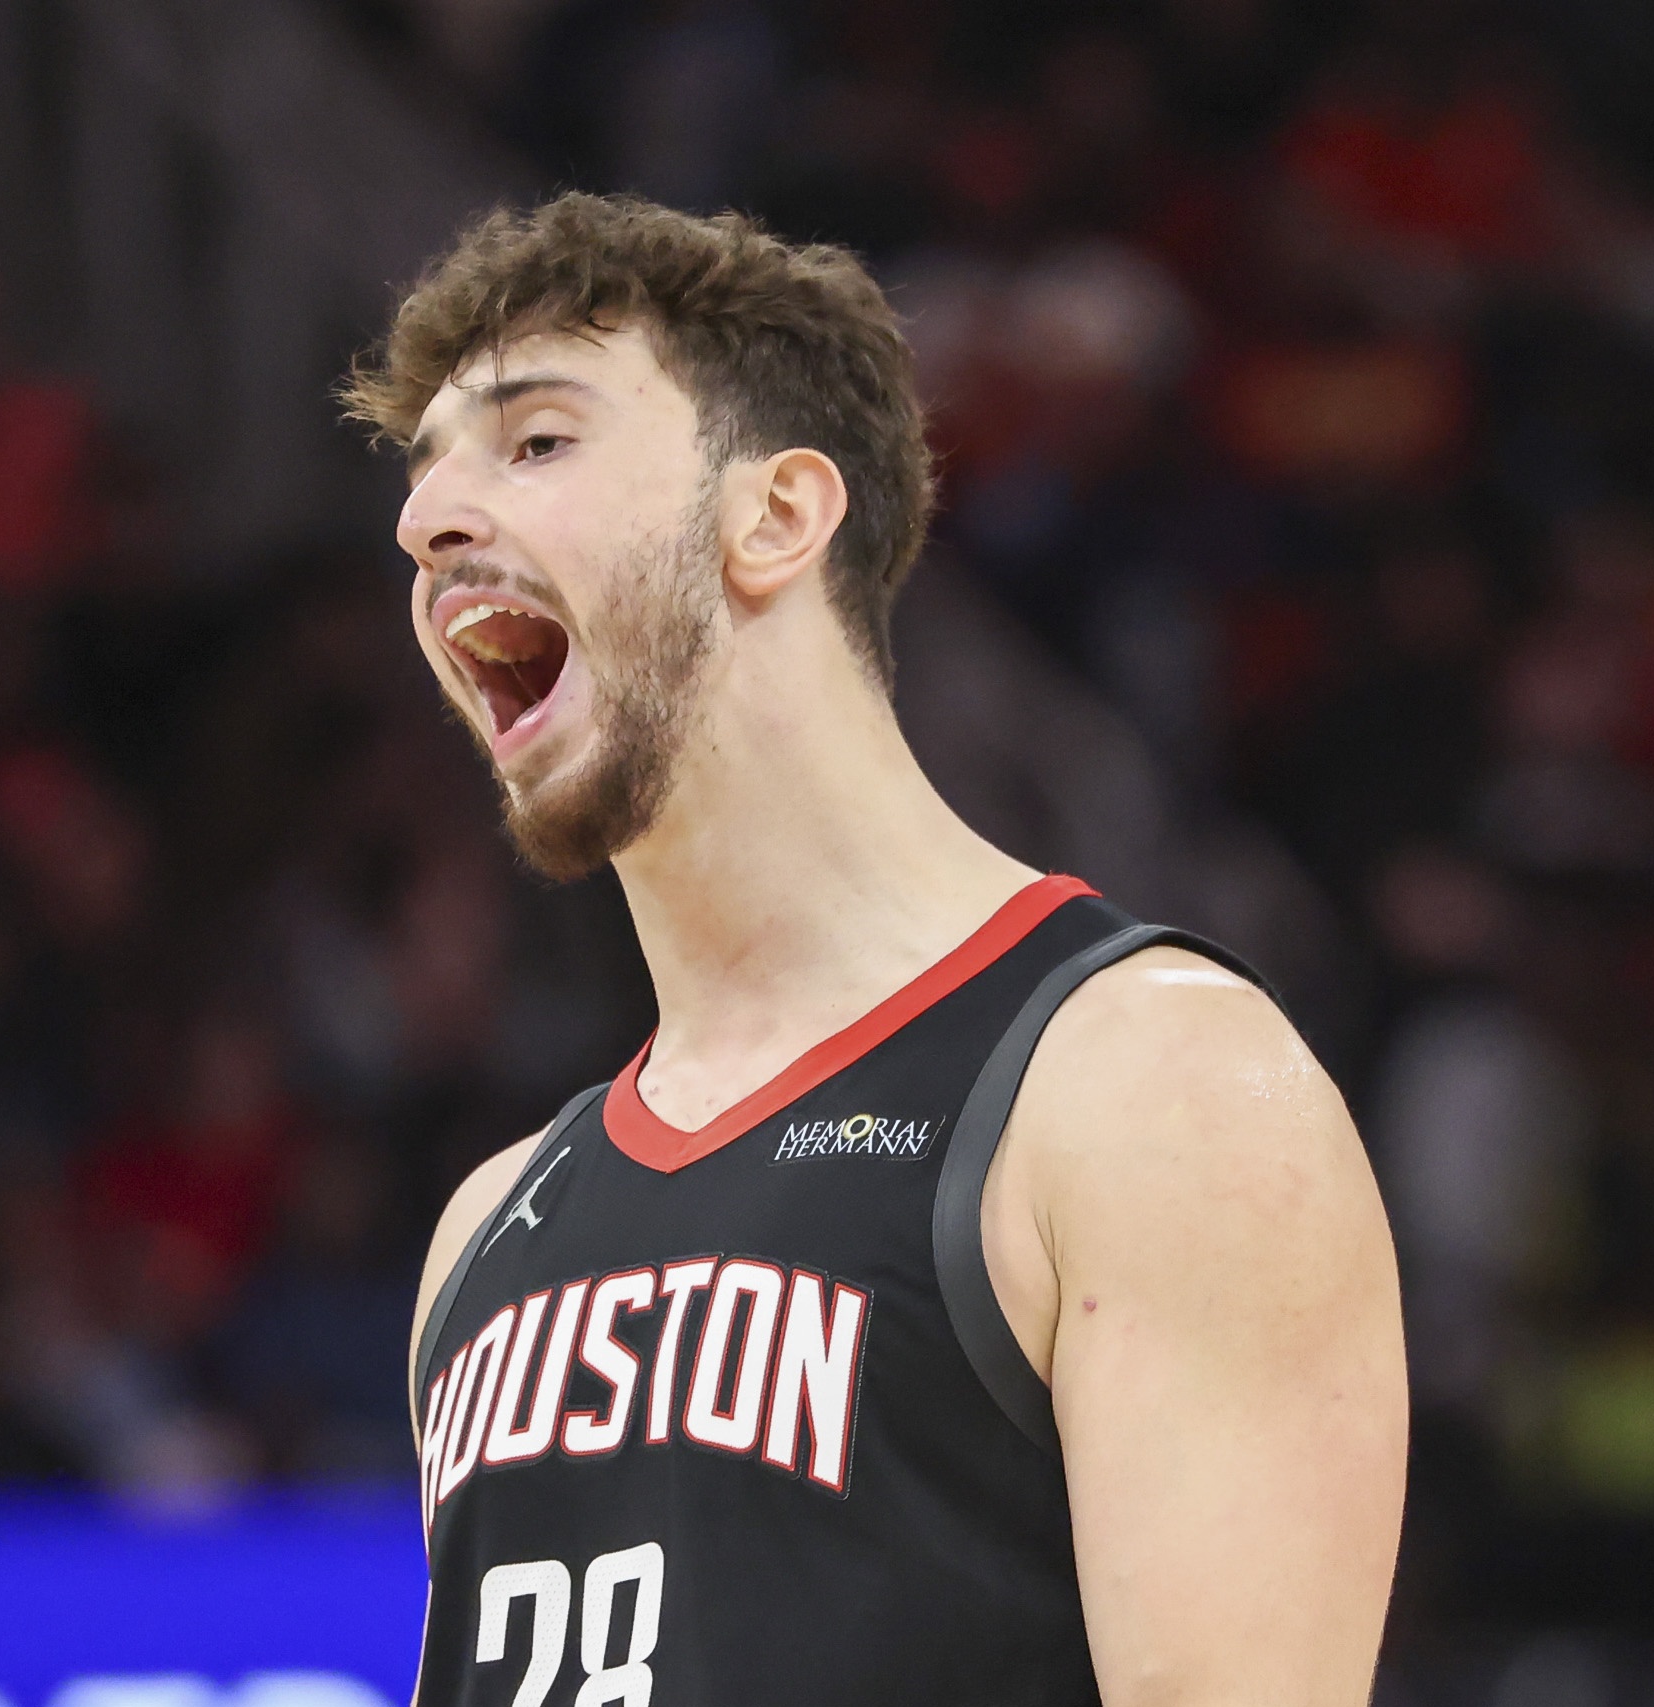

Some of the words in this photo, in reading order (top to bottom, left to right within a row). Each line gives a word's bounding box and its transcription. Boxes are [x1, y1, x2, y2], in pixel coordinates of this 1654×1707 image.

[781, 1113, 930, 1143] MEMORIAL
[773, 1135, 925, 1161] HERMANN
[420, 1255, 867, 1556] HOUSTON
